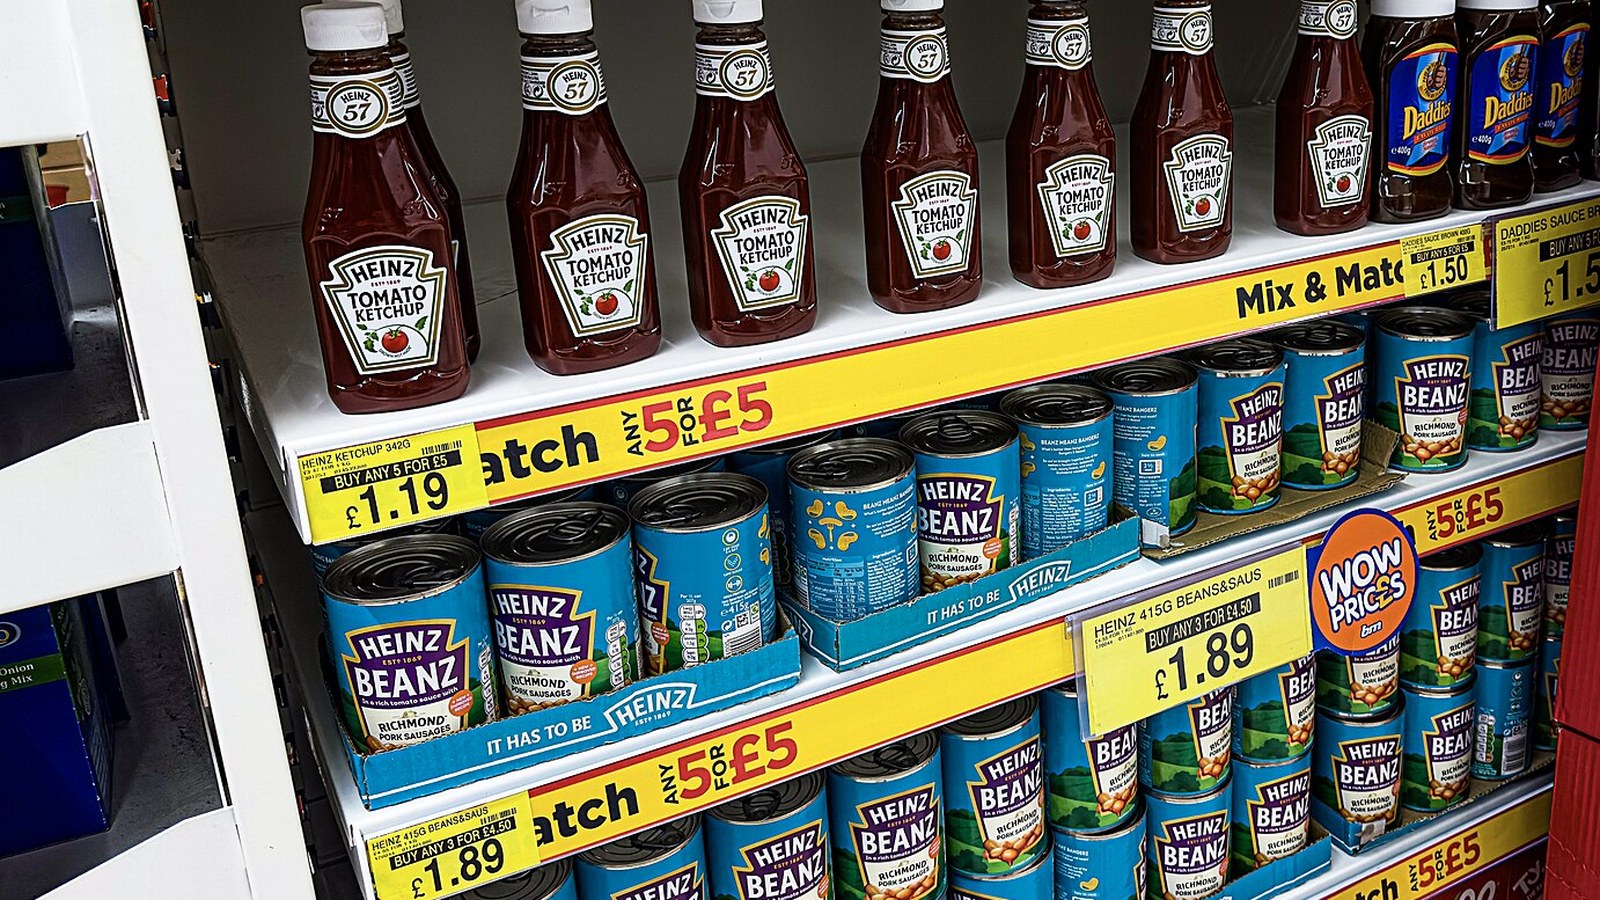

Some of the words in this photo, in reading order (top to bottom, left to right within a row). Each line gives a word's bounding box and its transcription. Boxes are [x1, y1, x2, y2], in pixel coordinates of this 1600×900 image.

[1191, 20, 1207, 28] HEINZ
[1335, 14, 1351, 28] 57
[1064, 34, 1083, 42] HEINZ
[1191, 28, 1207, 42] 57
[917, 43, 938, 53] HEINZ
[1064, 42, 1082, 56] 57
[734, 59, 757, 70] HEINZ
[918, 53, 937, 68] 57
[562, 71, 588, 82] HEINZ
[735, 70, 757, 86] 57
[340, 92, 371, 104] HEINZ
[564, 82, 588, 99] 57
[343, 103, 372, 122] 57
[1403, 102, 1451, 139] Daddies
[1484, 93, 1532, 129] Daddies
[1328, 126, 1360, 141] HEINZ
[1185, 145, 1220, 163] HEINZ
[1323, 143, 1363, 161] TOMATO
[1325, 157, 1361, 170] KETCHUP
[1061, 166, 1099, 184] HEINZ
[1180, 164, 1223, 183] TOMATO
[1183, 177, 1221, 193] KETCHUP
[917, 182, 958, 202] HEINZ
[1056, 186, 1104, 205] TOMATO
[740, 208, 788, 230] HEINZ
[912, 204, 965, 224] TOMATO
[1059, 200, 1102, 215] KETCHUP
[916, 218, 963, 235] KETCHUP
[1501, 219, 1547, 240] DADDIES
[1550, 209, 1585, 228] SAUCE
[1588, 205, 1600, 218] BR
[571, 227, 623, 250] HEINZ
[734, 230, 794, 252] TOMATO
[1402, 238, 1423, 247] DADDIES
[1425, 234, 1439, 243] SAUCE
[1441, 231, 1459, 239] BROWN
[1550, 241, 1565, 256] BUY
[1568, 236, 1584, 251] ANY
[1586, 233, 1590, 247] 5
[567, 251, 633, 275] TOMATO
[739, 246, 792, 264] KETCHUP
[1417, 253, 1429, 261] BUY
[1431, 250, 1442, 259] ANY
[1449, 246, 1460, 255] FOR
[1461, 243, 1468, 251] £5
[352, 260, 415, 284] HEINZ
[573, 267, 631, 288] KETCHUP
[1420, 255, 1467, 289] £1.50
[1544, 251, 1600, 307] £1.5
[348, 286, 427, 309] TOMATO
[1236, 281, 1293, 318] Mix
[1304, 272, 1326, 302] &
[1336, 258, 1404, 296] Matc
[356, 303, 424, 322] KETCHUP
[1415, 362, 1463, 379] HEINZ
[1241, 389, 1278, 417] HEINZ
[1403, 382, 1466, 408] BEANZ
[623, 410, 646, 455] ANY
[642, 400, 678, 452] 5
[677, 397, 699, 446] FOR
[699, 381, 773, 444] £5
[1232, 410, 1282, 447] BEANZ
[302, 455, 332, 469] HEINZ
[335, 445, 382, 462] KETCHUP
[386, 439, 410, 452] 342G
[480, 425, 599, 486] atch
[334, 474, 360, 488] BUY
[365, 467, 390, 482] ANY
[393, 464, 400, 476] 5
[405, 460, 430, 473] FOR
[433, 455, 447, 468] £5
[346, 472, 448, 529] £1.19
[923, 481, 985, 501] HEINZ
[918, 508, 993, 535] BEANZ
[1426, 510, 1438, 540] ANY
[1437, 503, 1455, 538] 5
[1454, 499, 1465, 533] FOR
[1466, 486, 1503, 530] £5
[928, 553, 979, 563] RICHMOND
[1319, 538, 1401, 600] WOW
[1018, 563, 1066, 596] HEINZ
[500, 594, 566, 618] HEINZ
[927, 613, 937, 624] IT
[941, 603, 964, 620] HAS
[968, 595, 983, 610] TO
[986, 589, 1000, 602] BE
[1095, 613, 1136, 638] HEINZ
[1140, 600, 1173, 621] 415G
[1176, 568, 1261, 608] BEANS&SAUS
[1149, 630, 1169, 649] BUY
[1173, 621, 1193, 639] ANY
[1196, 618, 1201, 632] 3
[1204, 609, 1225, 627] FOR
[1227, 600, 1252, 621] £4.50
[1360, 621, 1382, 638] bm
[359, 630, 442, 659] HEINZ
[497, 622, 582, 657] BEANZ
[0, 663, 35, 676] Onion
[1155, 622, 1254, 700] £1.89
[11, 675, 33, 686] Mix
[355, 655, 458, 698] BEANZ
[511, 676, 567, 688] RICHMOND
[420, 694, 441, 702] sauce
[443, 687, 458, 696] with
[615, 691, 687, 726] HEINZ
[379, 715, 445, 732] RICHMOND
[380, 733, 403, 741] PORK
[404, 724, 450, 740] SAUSAGES
[486, 740, 501, 755] IT
[506, 730, 541, 749] HAS
[544, 724, 568, 742] TO
[572, 716, 592, 731] BE
[988, 744, 1038, 780] HEINZ
[1349, 741, 1398, 760] HEINZ
[659, 764, 679, 804] ANY
[678, 750, 711, 799] 5
[710, 743, 729, 790] FOR
[729, 721, 798, 784] £5
[1340, 759, 1398, 784] BEANZ
[980, 760, 1042, 810] BEANZ
[1267, 775, 1309, 802] HEINZ
[533, 783, 639, 846] atch
[869, 792, 928, 826] HEINZ
[1257, 798, 1310, 827] BEANZ
[372, 835, 400, 850] HEINZ
[404, 827, 426, 841] 415G
[428, 807, 488, 832] BEANS&SAUS
[860, 812, 936, 855] BEANZ
[1172, 817, 1223, 841] HEINZ
[394, 853, 417, 867] BUY
[422, 843, 444, 858] ANY
[447, 839, 454, 850] 3
[457, 831, 480, 846] FOR
[483, 819, 511, 837] £4.50
[754, 830, 814, 868] HEINZ
[1164, 837, 1226, 867] BEANZ
[412, 839, 504, 899] £1.89
[878, 860, 928, 880] RICHMOND
[1418, 854, 1435, 888] 5
[1435, 849, 1445, 881] FOR
[1444, 832, 1481, 876] £5
[746, 849, 824, 896] BEANZ
